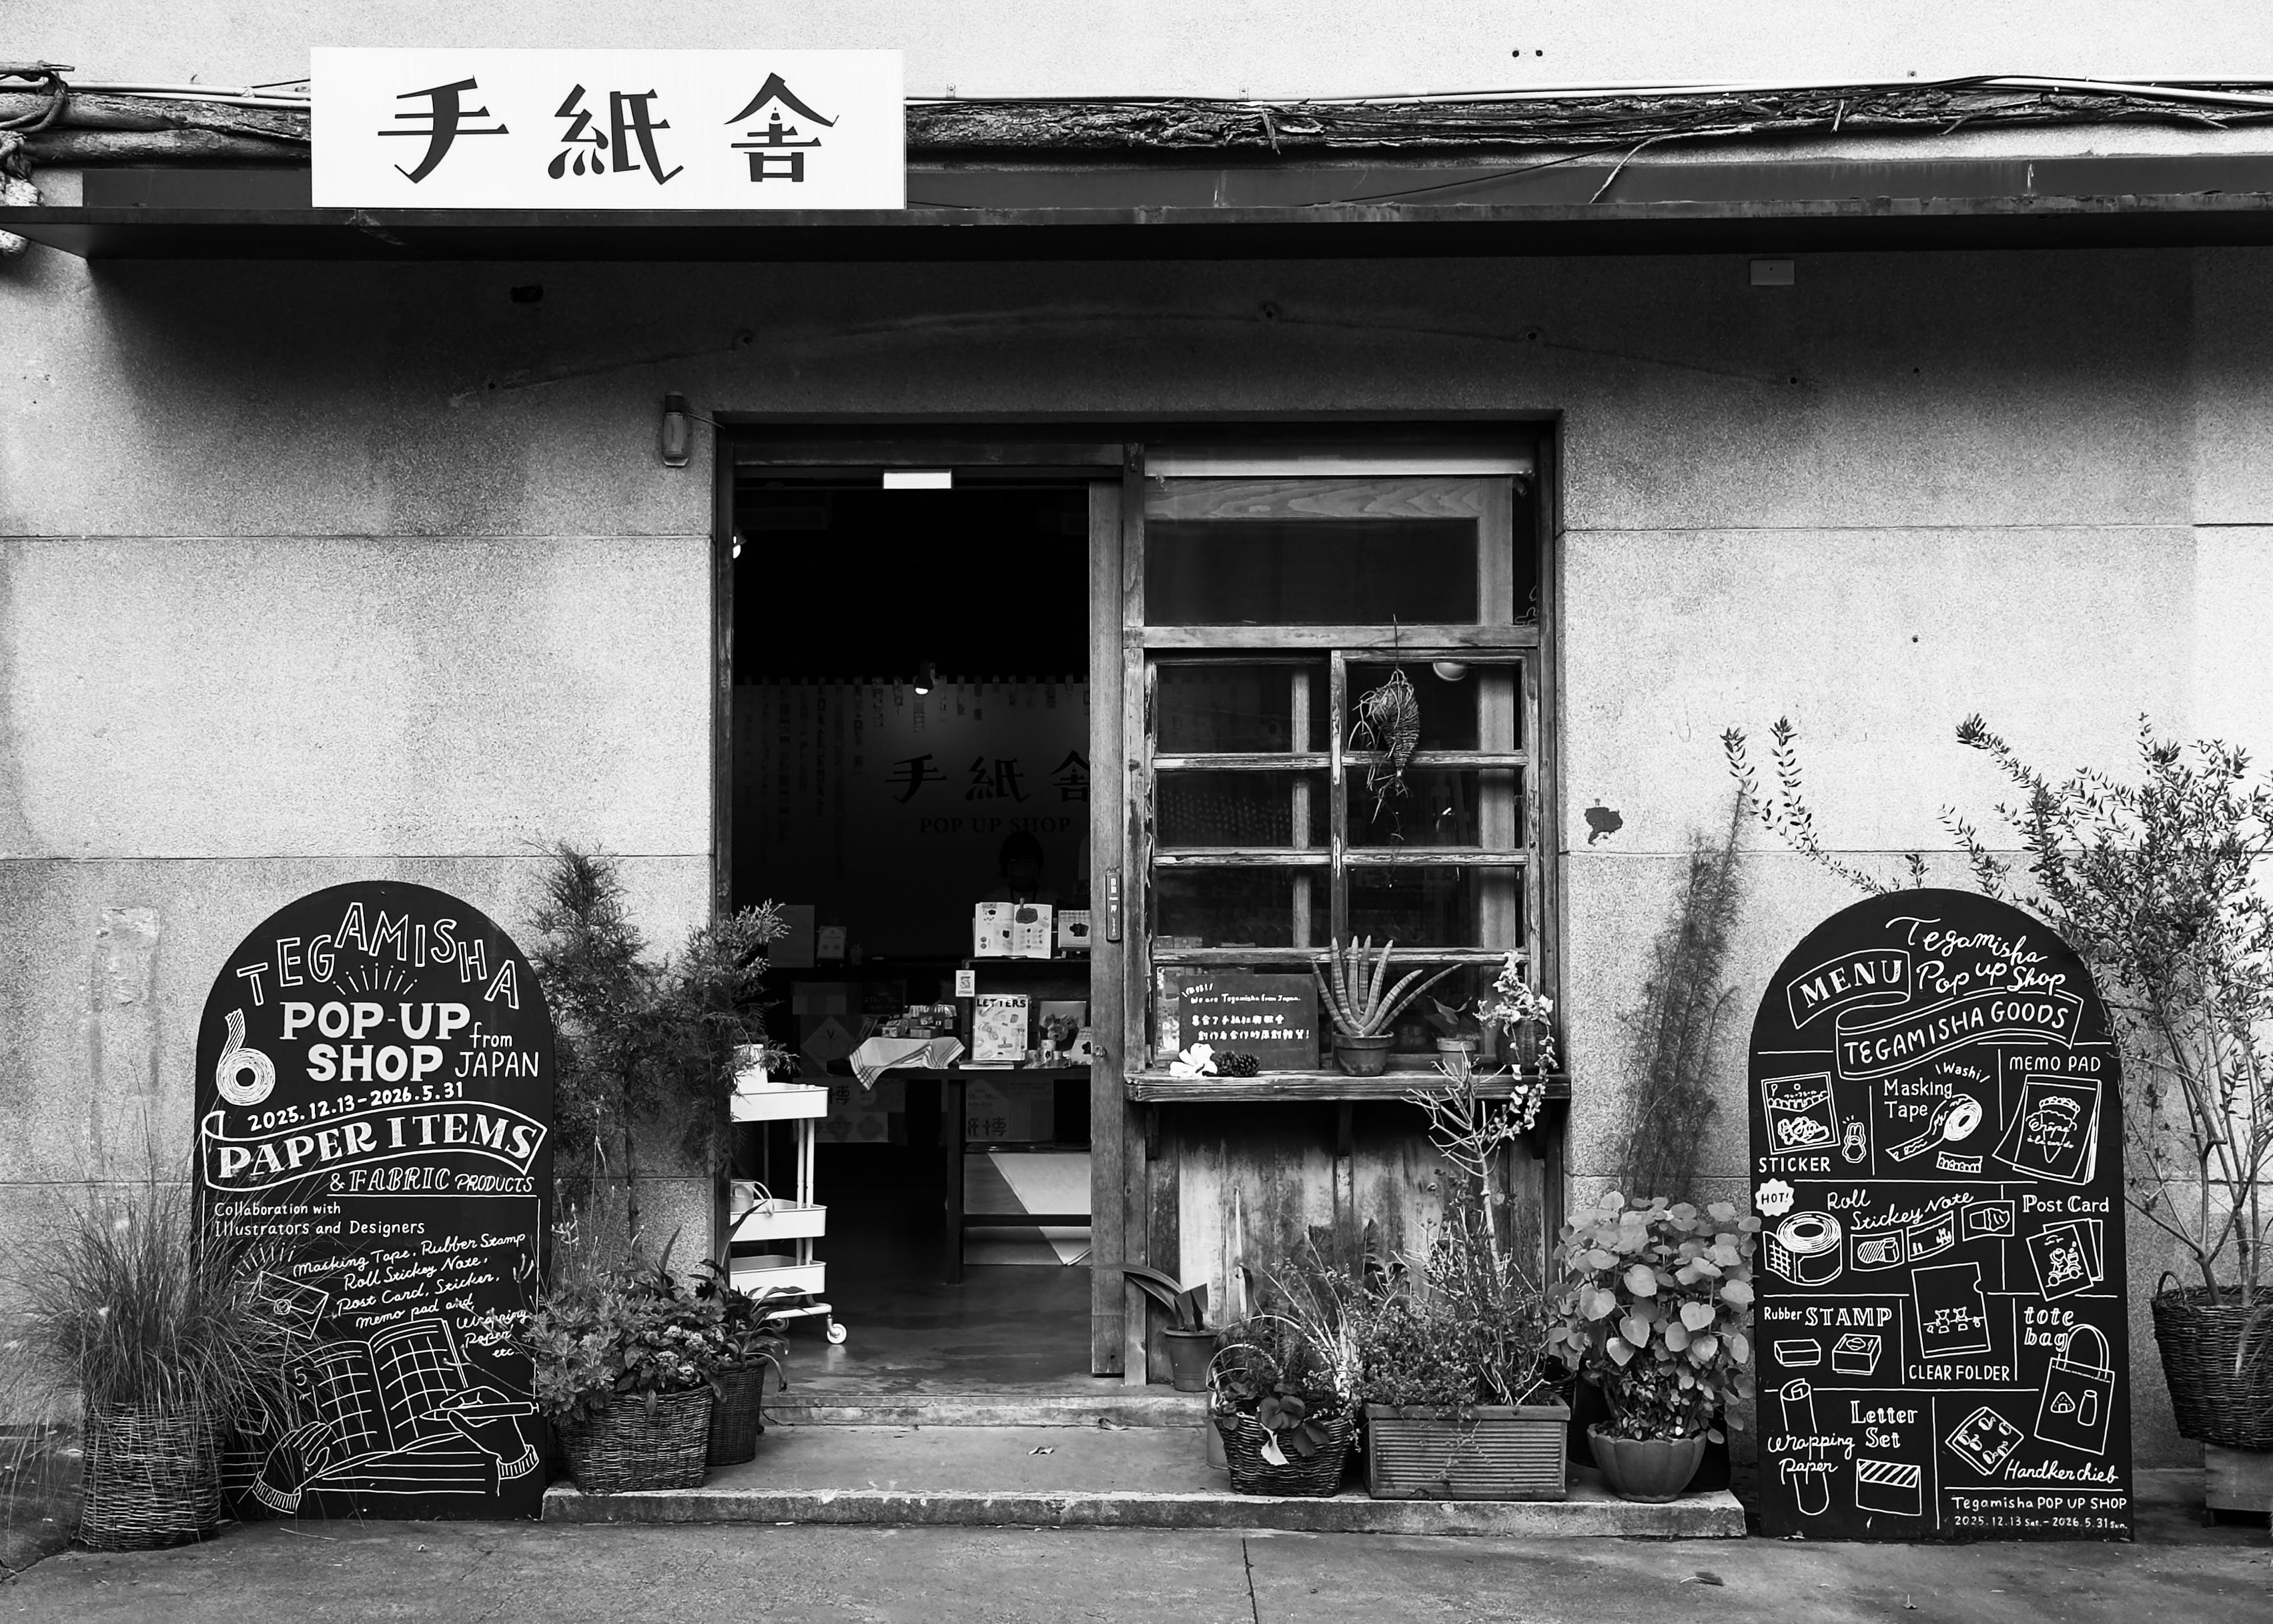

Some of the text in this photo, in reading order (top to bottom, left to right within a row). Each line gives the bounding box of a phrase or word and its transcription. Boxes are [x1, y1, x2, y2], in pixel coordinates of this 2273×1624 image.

[919, 817, 1071, 833] POP UP SHOP
[1885, 917, 2048, 966] Tegamisha
[236, 902, 519, 1009] TEGAMISHA
[1800, 960, 1902, 1008] MENU
[1916, 960, 2066, 995] Pop up Shop
[977, 998, 1026, 1007] LETTERS
[280, 1001, 470, 1040] POP-UP
[470, 1022, 512, 1049] from
[1844, 1001, 2069, 1065] TEGAMISHA GOODS
[306, 1044, 443, 1082] SHOP
[455, 1052, 538, 1078] JAPAN
[2010, 1056, 2101, 1072] MEMO PAD
[1884, 1079, 1953, 1098] Masking
[1889, 1101, 1928, 1122] Tape
[217, 1114, 536, 1178] PAPER ITEMS
[1759, 1157, 1831, 1173] STICKER
[330, 1167, 534, 1192] & FABRIC PRODUCTS
[1761, 1192, 1789, 1203] HOT!
[1827, 1189, 1871, 1210] Roll
[2023, 1195, 2110, 1213] Post Card
[215, 1202, 341, 1216] Collaboration with
[1851, 1192, 1974, 1230] Stickey Note
[215, 1220, 425, 1237] Illustrators and Designers
[421, 1236, 477, 1255] Rubber
[480, 1234, 526, 1248] Stamp
[344, 1269, 381, 1290] Roll
[384, 1262, 437, 1282] Stickey
[411, 1298, 438, 1321] pad
[1764, 1307, 1892, 1327] Rubber STAMP
[2023, 1306, 2074, 1326] tote
[2024, 1327, 2068, 1352] bag
[1909, 1365, 2010, 1382] CLEAR FOLDER
[1851, 1400, 1918, 1425] Letter
[1866, 1427, 1901, 1449] Set
[1951, 1497, 2127, 1511] Tegamisha POP UP SHOP
[1955, 1516, 2021, 1526] 2025.12.13
